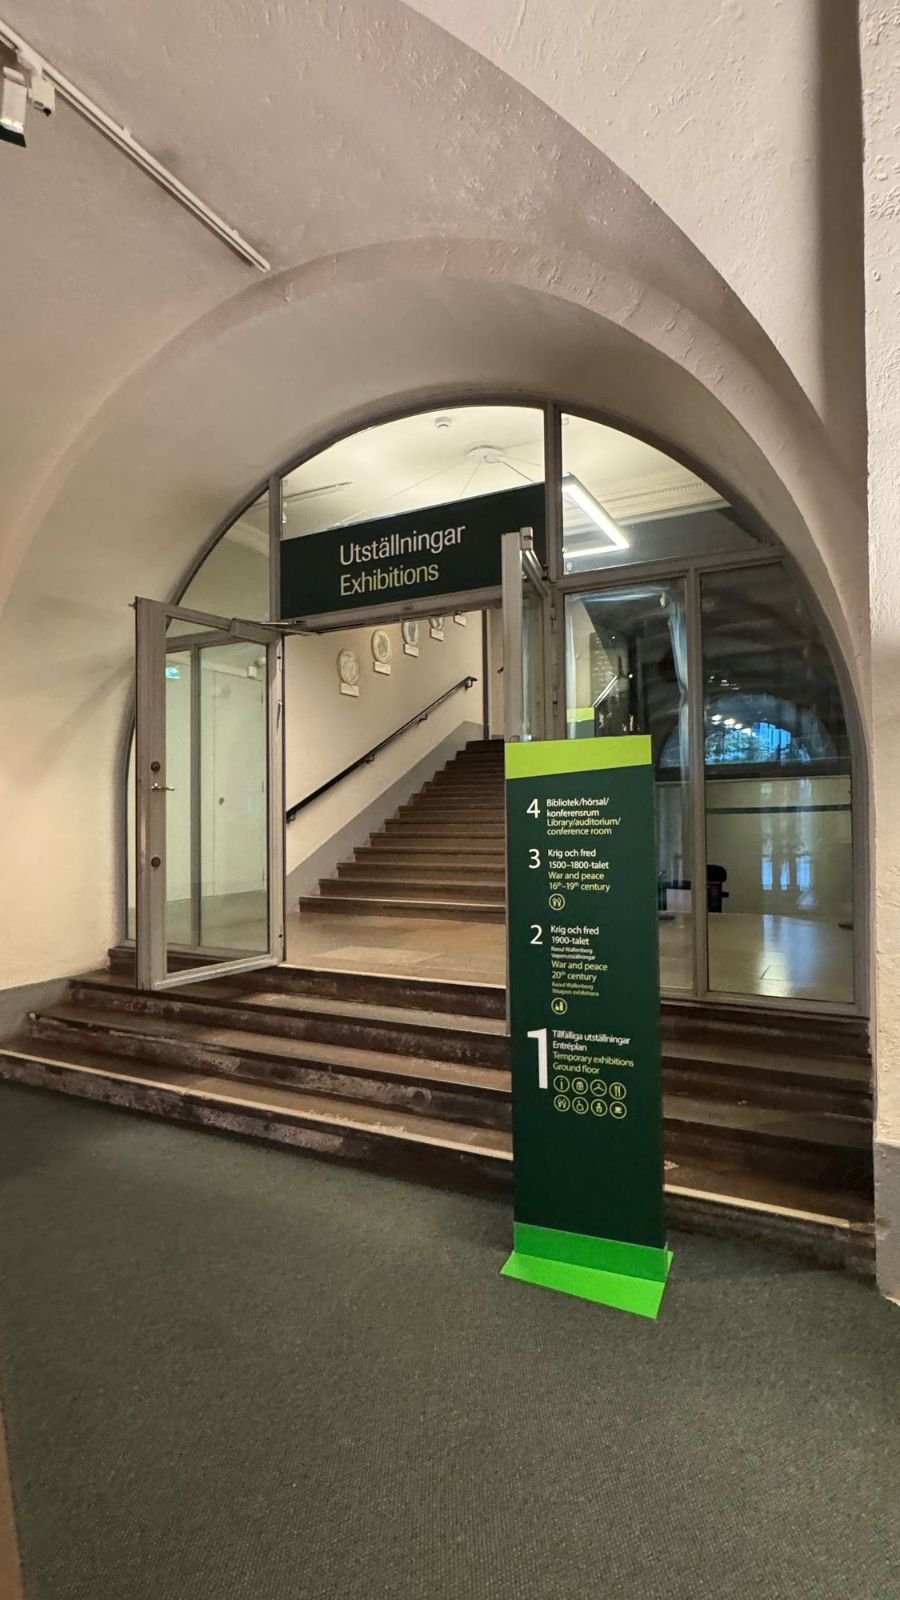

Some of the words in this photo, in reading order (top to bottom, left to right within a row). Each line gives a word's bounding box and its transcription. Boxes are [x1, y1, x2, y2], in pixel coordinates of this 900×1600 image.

[339, 524, 466, 566] Utställningar
[340, 563, 439, 597] Exhibitions
[546, 797, 609, 807] Bibliotek/hörsal/
[526, 798, 541, 819] 4
[547, 809, 599, 817] konferensrum
[547, 817, 621, 828] Library/auditorium/
[547, 827, 589, 836] conference
[590, 828, 612, 836] room
[528, 848, 541, 869] 3
[547, 849, 563, 859] Krig
[564, 849, 579, 857] och
[580, 848, 596, 857] fred
[548, 872, 563, 880] War
[564, 872, 580, 880] and
[581, 872, 605, 882] peace
[580, 882, 611, 893] century
[530, 924, 543, 945] 2
[550, 925, 566, 935] Krig
[567, 925, 582, 934] och
[583, 925, 600, 935] fred
[551, 936, 590, 945] 1900-talet
[551, 960, 567, 969] War
[567, 961, 583, 970] and
[584, 962, 608, 972] peace
[567, 972, 597, 983] century
[584, 1032, 631, 1046] utställningar
[552, 1040, 588, 1052] Entréplan
[527, 1028, 548, 1089] 1
[552, 1052, 593, 1064] Temporary
[593, 1055, 635, 1067] exhibitions
[552, 1063, 581, 1072] Ground
[581, 1064, 601, 1074] floor
